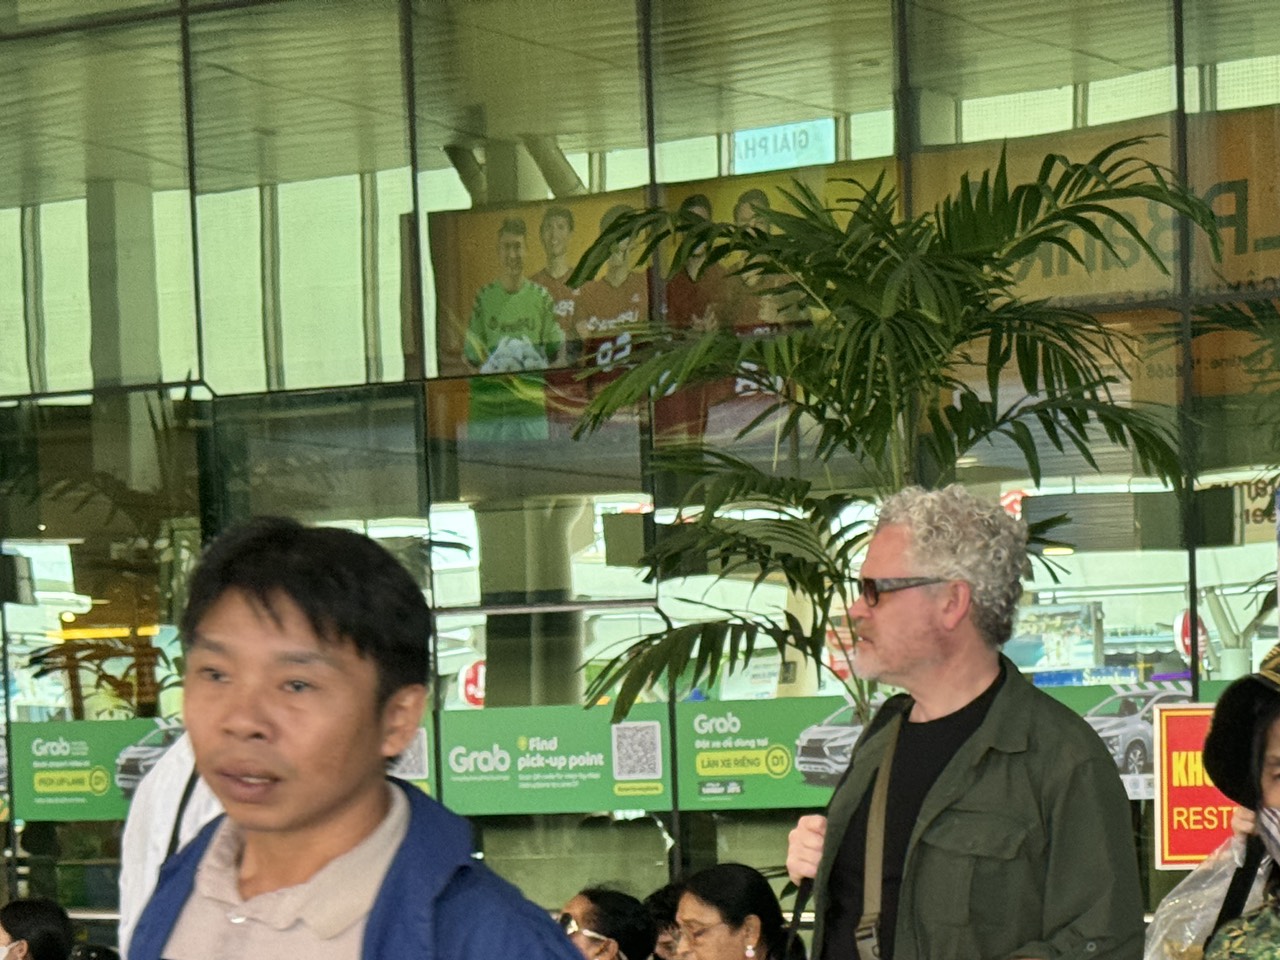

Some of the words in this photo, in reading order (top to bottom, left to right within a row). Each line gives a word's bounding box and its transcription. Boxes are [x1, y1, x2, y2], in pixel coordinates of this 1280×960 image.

[693, 711, 741, 735] Grab
[31, 736, 70, 757] Grab
[529, 737, 558, 751] Find
[449, 743, 511, 774] Grab
[517, 753, 566, 771] pick-up
[568, 751, 605, 770] point
[1173, 806, 1238, 830] REST
